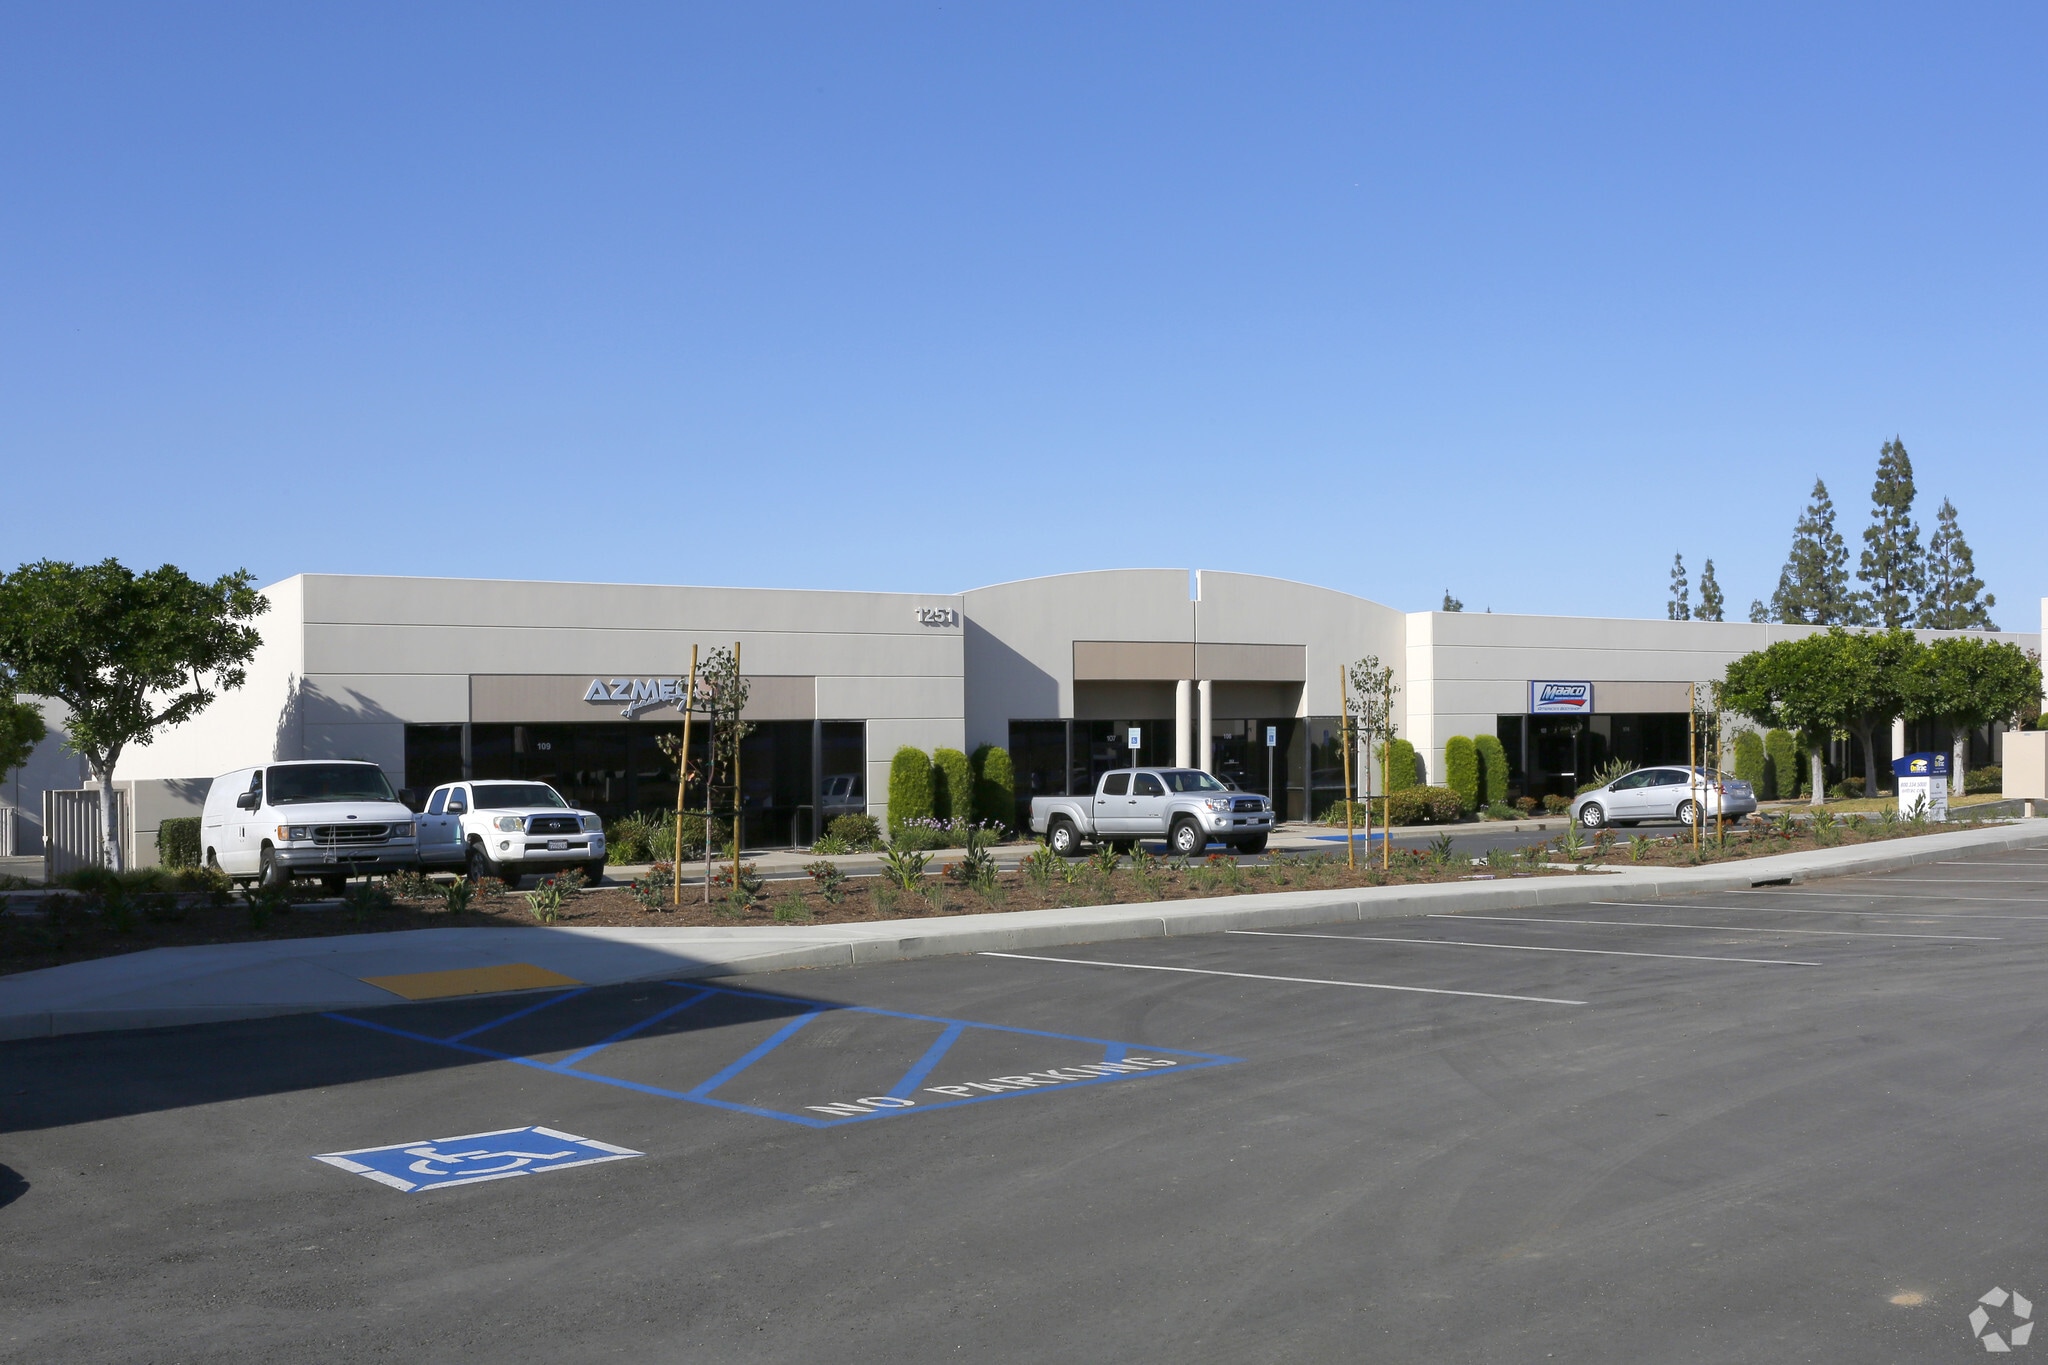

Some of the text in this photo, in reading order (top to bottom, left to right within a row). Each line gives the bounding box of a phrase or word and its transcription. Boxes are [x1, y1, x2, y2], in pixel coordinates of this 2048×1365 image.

[914, 606, 953, 623] 1251
[537, 742, 551, 750] 109
[804, 1057, 1177, 1116] NO PARKING
